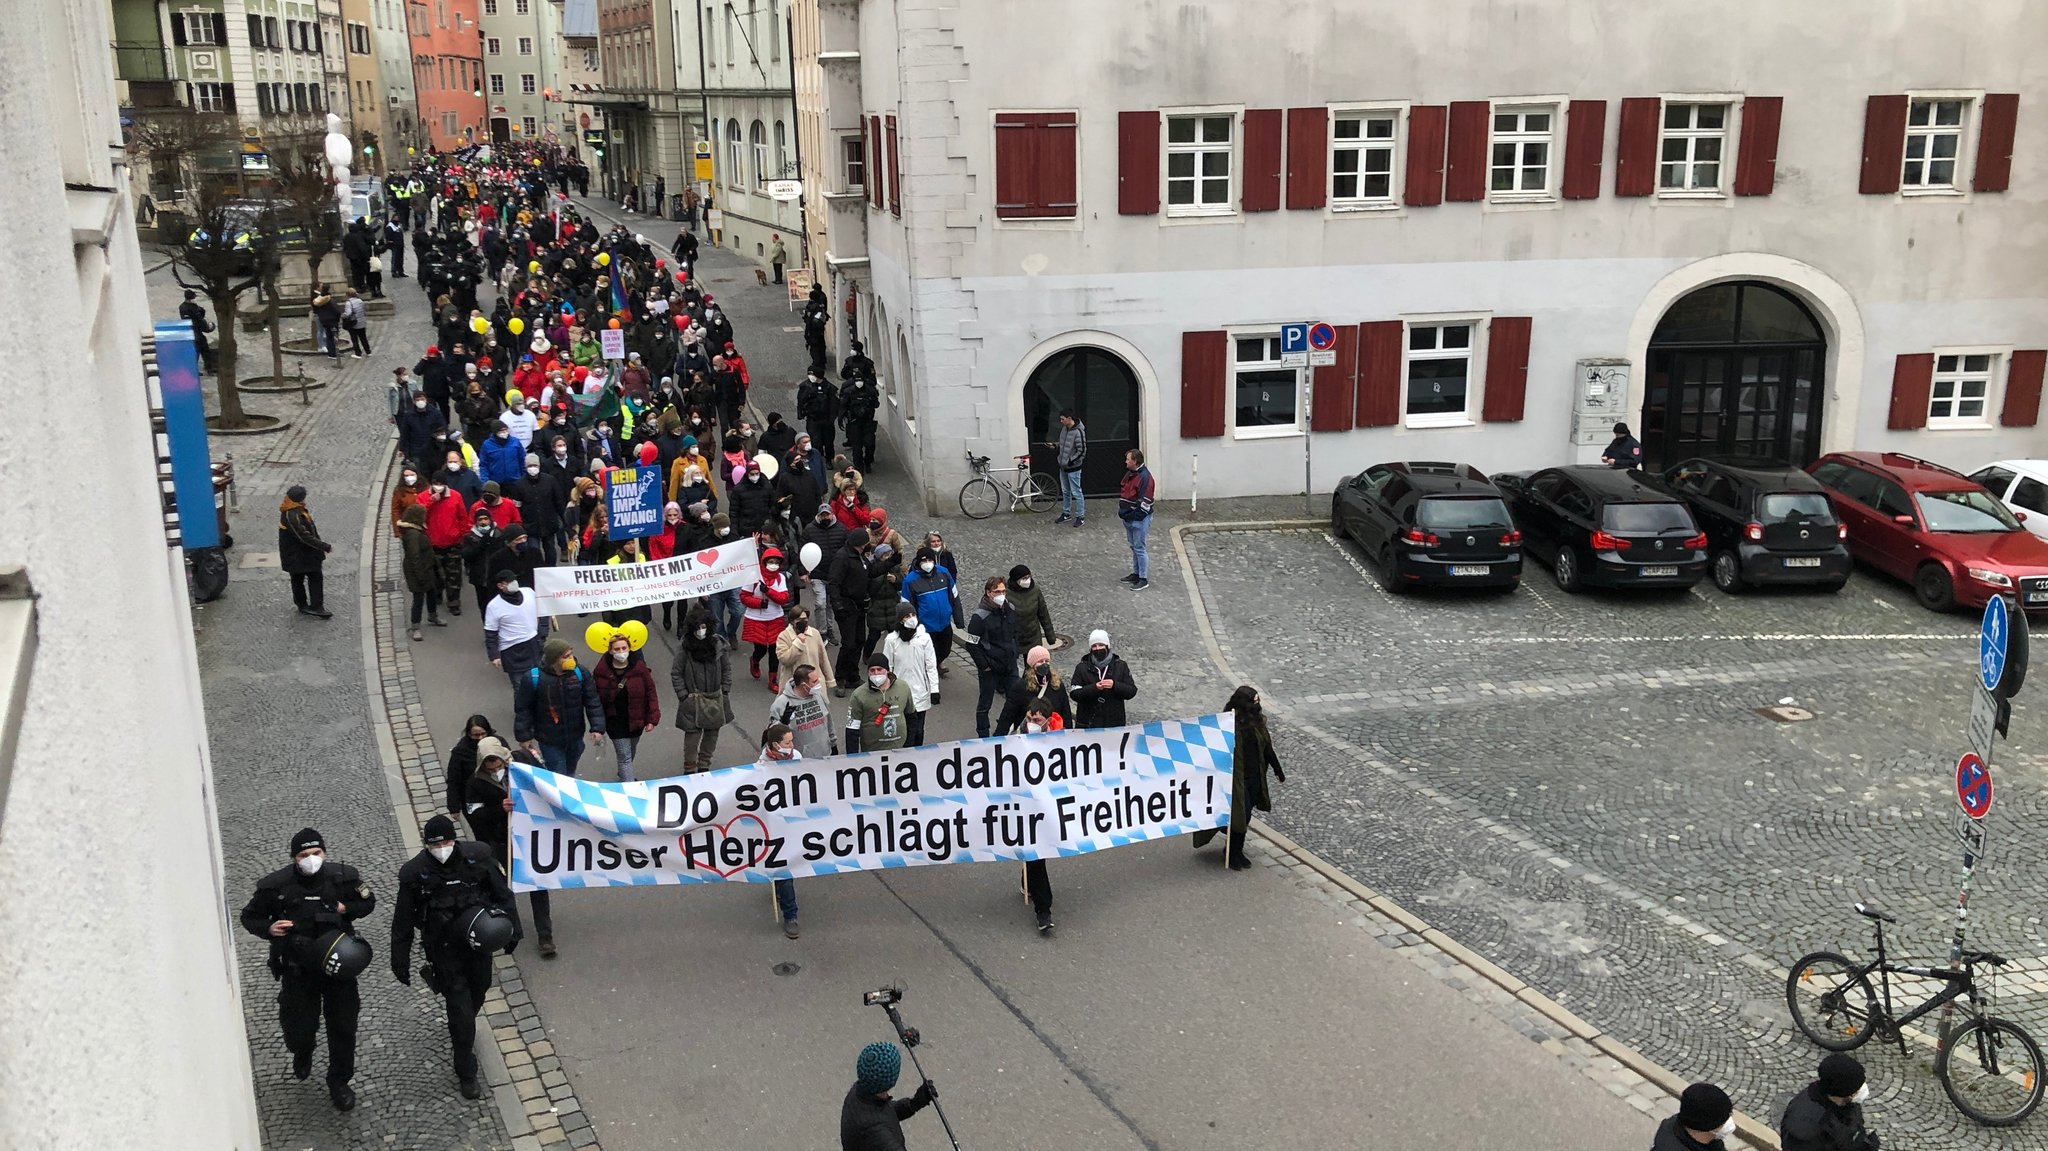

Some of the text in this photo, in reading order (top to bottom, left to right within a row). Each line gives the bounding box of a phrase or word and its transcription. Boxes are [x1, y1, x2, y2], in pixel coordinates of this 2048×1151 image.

[1287, 327, 1301, 349] P
[611, 468, 637, 485] NEIN
[612, 483, 638, 499] ZUM
[613, 496, 647, 513] IMPF-
[613, 509, 657, 527] ZWANG!
[552, 588, 611, 599] IMPFPFLICHT
[644, 579, 680, 590] UNSERE
[689, 572, 713, 582] ROTE
[722, 563, 745, 575] LINIE
[574, 557, 692, 584] PFLEGEKRÄFTE MIT
[580, 601, 600, 609] WIR
[603, 598, 628, 608] SIND
[673, 589, 694, 597] MAL
[697, 581, 723, 593] WEG!
[656, 732, 1130, 828] Do san mia dahoam !
[531, 775, 1214, 874] Unser Herz schlägt für Freiheit !
